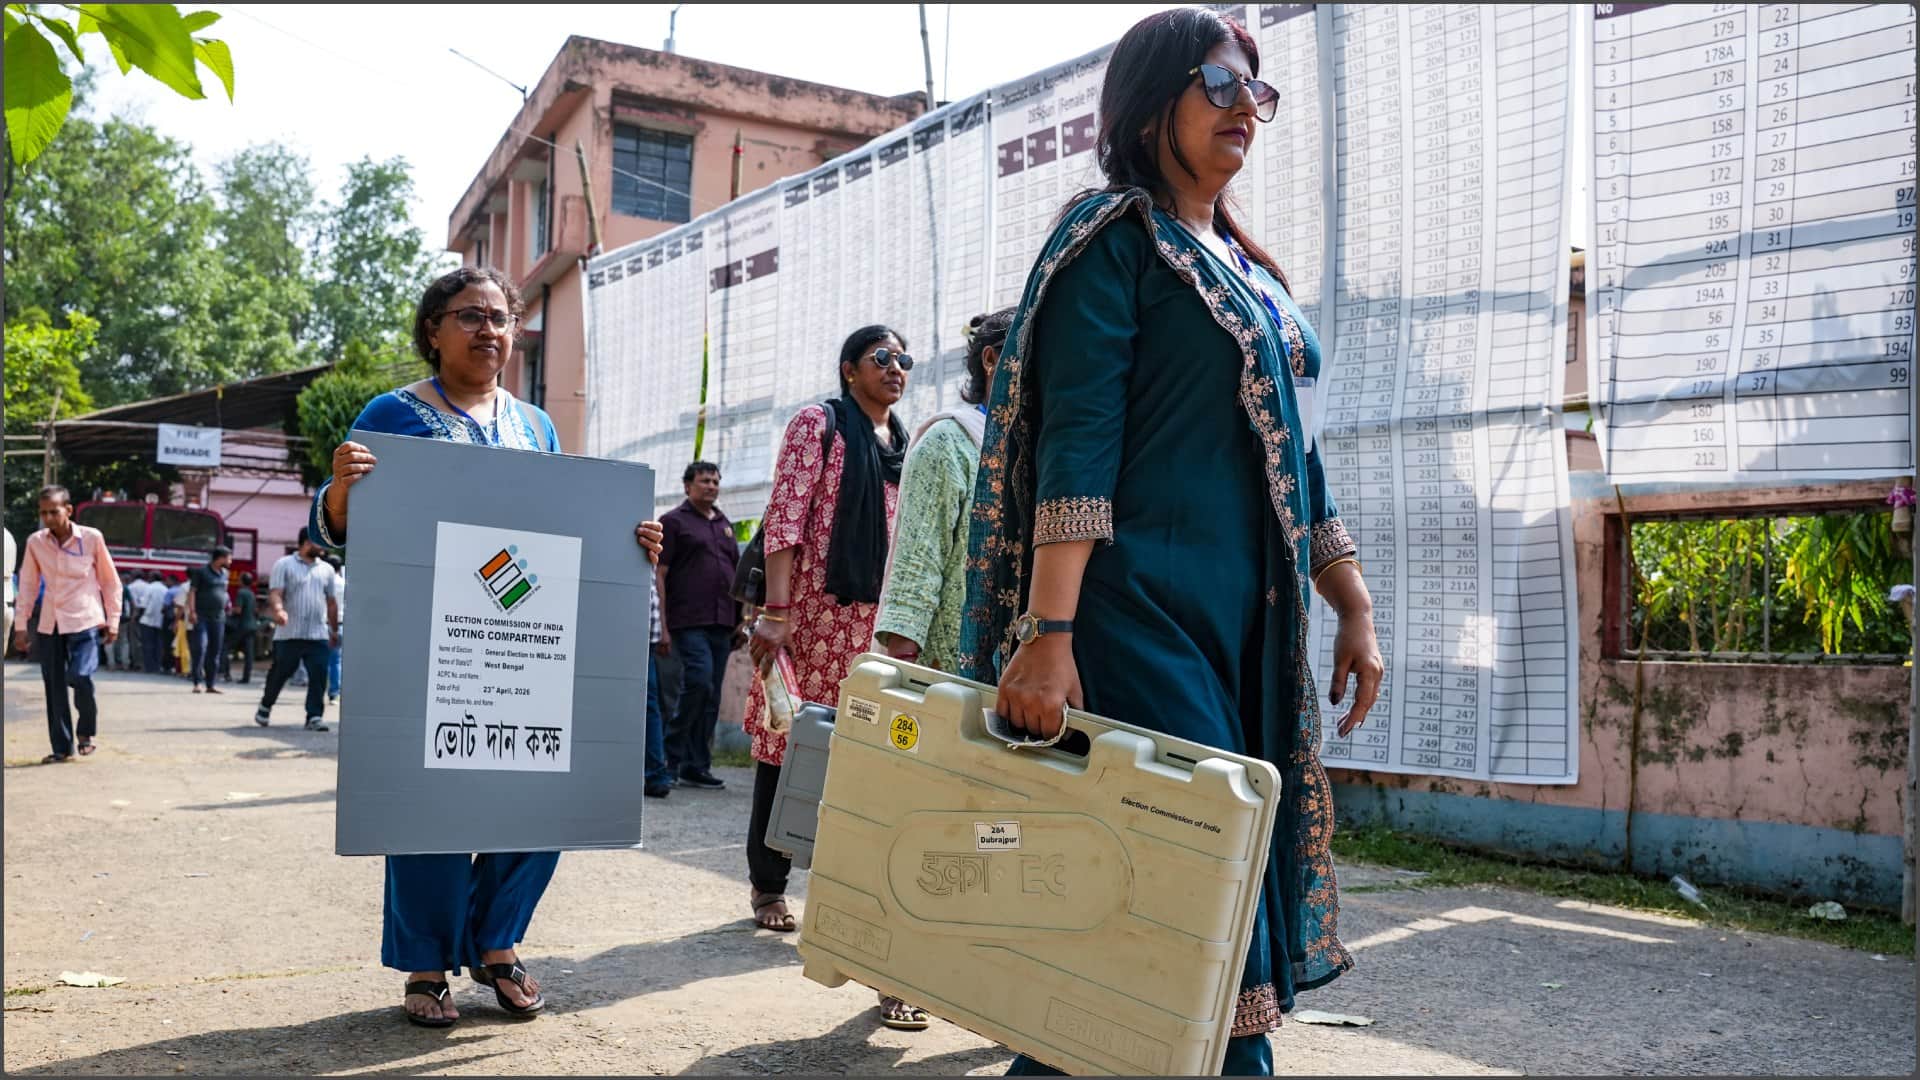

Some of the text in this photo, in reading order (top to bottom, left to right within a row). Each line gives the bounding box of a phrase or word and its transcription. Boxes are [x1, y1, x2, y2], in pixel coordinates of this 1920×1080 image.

[1597, 4, 1614, 15] No
[1775, 8, 1790, 22] 22
[1611, 24, 1616, 36] 1
[1714, 20, 1734, 37] 179
[1774, 33, 1789, 48] 23
[1610, 47, 1616, 59] 2
[1705, 46, 1734, 62] 178A
[1774, 58, 1788, 72] 24
[1610, 70, 1616, 82] 3
[1713, 70, 1734, 86] 178
[1773, 82, 1788, 98] 25
[1609, 93, 1616, 104] 4
[1720, 94, 1733, 108] 55
[1772, 108, 1788, 122] 26
[1610, 116, 1616, 128] 5
[1712, 118, 1732, 134] 158
[1610, 137, 1616, 150] 6
[1772, 132, 1787, 147] 27
[1712, 142, 1732, 158] 175
[1610, 160, 1616, 172] 7
[1771, 158, 1786, 172] 28
[1711, 166, 1731, 182] 172
[1611, 183, 1616, 195] 8
[1770, 182, 1785, 196] 29
[1896, 187, 1916, 202] 97
[1710, 191, 1730, 206] 193
[1612, 206, 1618, 218] 9
[1769, 207, 1784, 222] 30
[1709, 215, 1728, 230] 195
[1768, 232, 1782, 246] 31
[1705, 240, 1728, 254] 92A
[1766, 256, 1780, 270] 32
[1705, 264, 1727, 278] 209
[1764, 281, 1778, 294] 33
[1696, 288, 1724, 302] 194A
[1890, 290, 1914, 305] 170
[1708, 310, 1722, 324] 56
[1762, 306, 1776, 319] 34
[1895, 316, 1911, 330] 93
[1706, 334, 1720, 348] 95
[1760, 330, 1774, 343] 35
[1884, 342, 1908, 356] 194
[1696, 358, 1716, 372] 190
[1756, 354, 1770, 367] 36
[1890, 368, 1907, 382] 99
[1691, 381, 1712, 394] 177
[1752, 377, 1767, 390] 37
[1416, 421, 1434, 431] 229
[1452, 419, 1469, 428] 115
[176, 430, 200, 440] FIRE
[1693, 428, 1714, 442] 160
[1338, 442, 1355, 450] 180
[1372, 440, 1388, 448] 122
[164, 446, 210, 458] BRIGADE
[1696, 452, 1716, 466] 212
[1340, 504, 1358, 512] 184
[1380, 502, 1391, 511] 72
[1420, 502, 1438, 510] 234
[1460, 500, 1474, 509] 40
[1374, 518, 1392, 527] 224
[1421, 518, 1439, 526] 235
[1456, 517, 1474, 526] 112
[1375, 534, 1392, 542] 246
[1422, 534, 1440, 542] 236
[1462, 534, 1474, 542] 46
[1376, 549, 1392, 558] 179
[1422, 549, 1440, 558] 237
[1456, 549, 1475, 558] 265
[1381, 564, 1392, 573] 27
[1422, 565, 1440, 574] 238
[1456, 566, 1476, 575] 210
[1380, 580, 1392, 588] 93
[1422, 581, 1440, 590] 239
[1450, 582, 1476, 590] 211A
[1374, 596, 1393, 604] 229
[1422, 597, 1440, 606] 240
[445, 614, 482, 624] ELECTION
[484, 618, 530, 629] COMMISSION
[447, 628, 560, 645] VOTING COMPARTMENT
[485, 648, 506, 656] General
[507, 650, 528, 658] Election
[502, 662, 524, 672] Bengal
[1420, 676, 1440, 685] 245
[1456, 678, 1476, 688] 288
[496, 686, 512, 696] April,
[515, 688, 530, 696] 2026
[1420, 691, 1440, 700] 246
[436, 696, 450, 706] Polling
[1463, 694, 1475, 704] 79
[1420, 707, 1438, 716] 247
[1456, 710, 1474, 720] 247
[896, 718, 912, 732] 284
[1375, 720, 1388, 728] 16
[1419, 722, 1438, 732] 248
[434, 709, 562, 761] ভোট দান কক্ষ
[1456, 726, 1474, 735] 297
[897, 734, 908, 746] 56
[1366, 734, 1386, 744] 267
[1418, 738, 1438, 748] 249
[1328, 746, 1348, 756] 200
[1455, 741, 1474, 752] 280
[1374, 750, 1386, 760] 12
[1417, 754, 1437, 764] 250
[1454, 758, 1472, 768] 228
[1121, 796, 1149, 810] Election
[1150, 806, 1193, 824] Commission
[1203, 822, 1221, 834] India
[980, 836, 1018, 845] Dubrajpur
